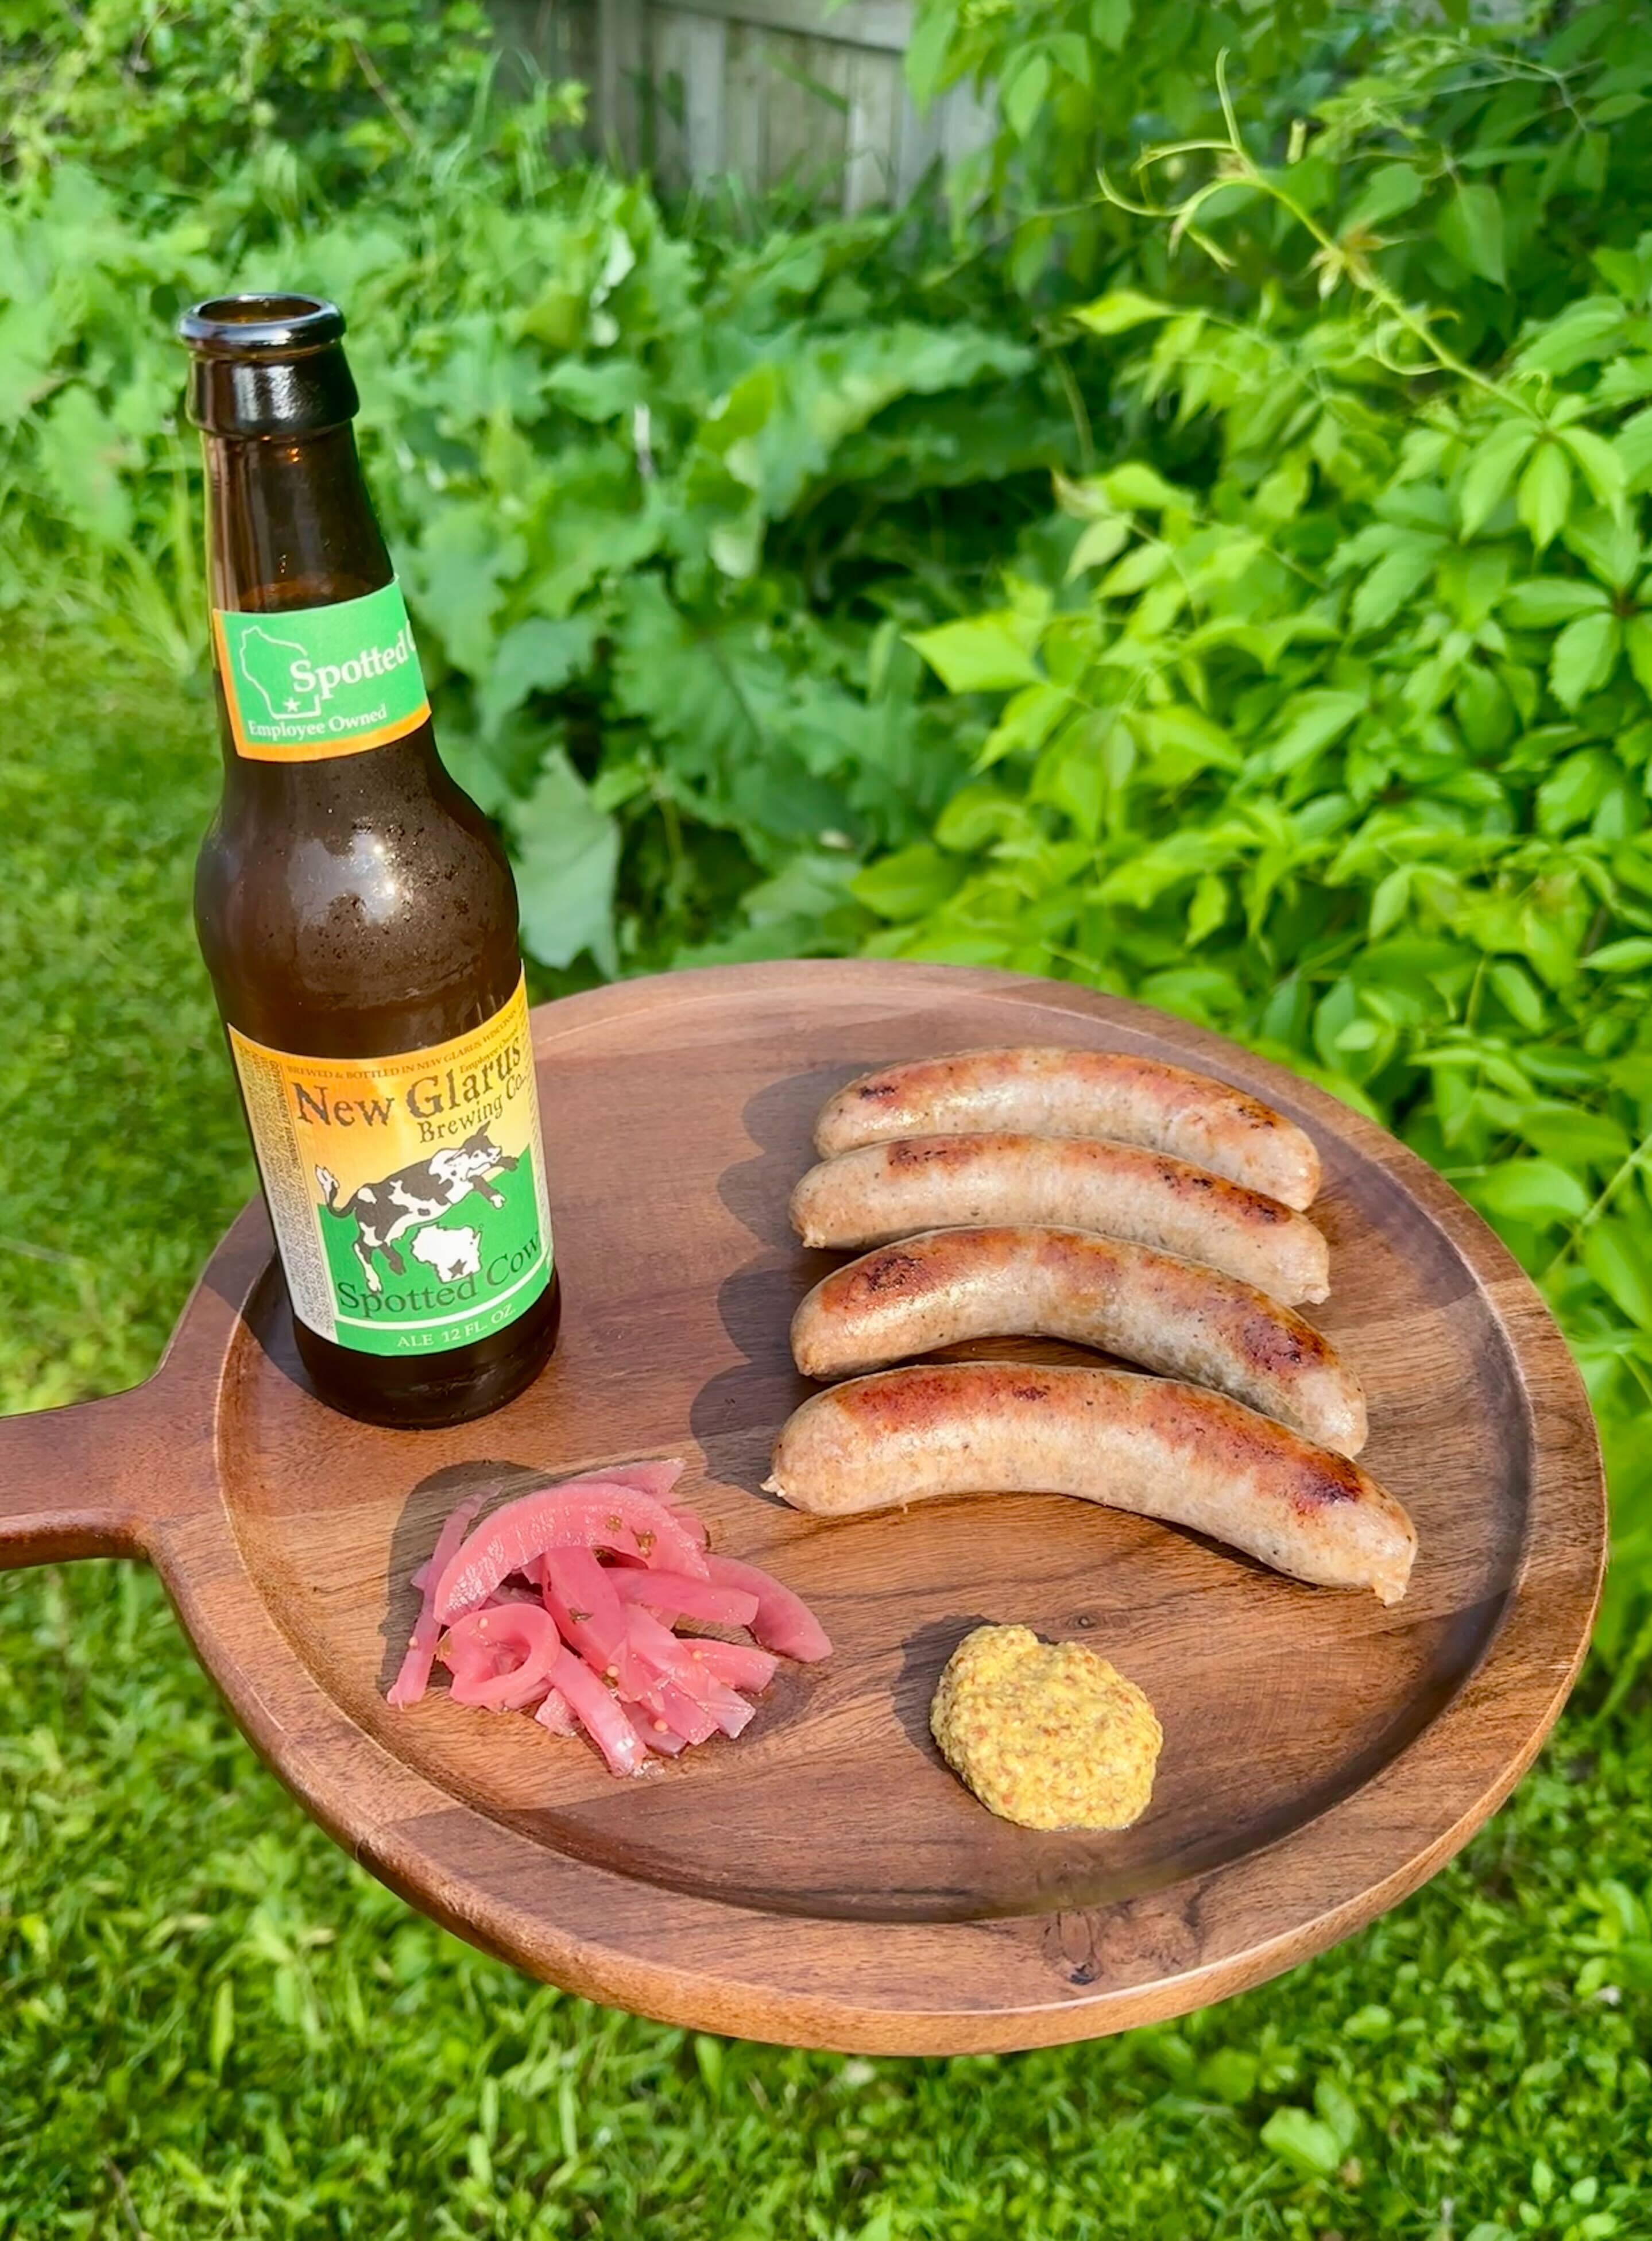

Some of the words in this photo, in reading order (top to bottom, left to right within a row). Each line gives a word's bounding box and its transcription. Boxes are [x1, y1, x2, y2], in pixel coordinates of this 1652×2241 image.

[289, 629, 409, 701] Spotted
[247, 720, 326, 741] Employee
[328, 704, 388, 732] Owned
[287, 1065, 333, 1079] BREWED
[335, 1071, 344, 1079] &
[346, 1067, 400, 1079] BOTTLED
[402, 1064, 415, 1075] IN
[416, 1056, 442, 1071] NEW
[291, 1080, 395, 1128] New
[406, 1036, 521, 1119] Glarus
[416, 1094, 503, 1144] Brewing
[338, 1271, 478, 1319] Spotted
[486, 1230, 539, 1286] Cow
[397, 1332, 435, 1347] ALE
[442, 1327, 462, 1343] 12
[464, 1319, 488, 1338] FL.
